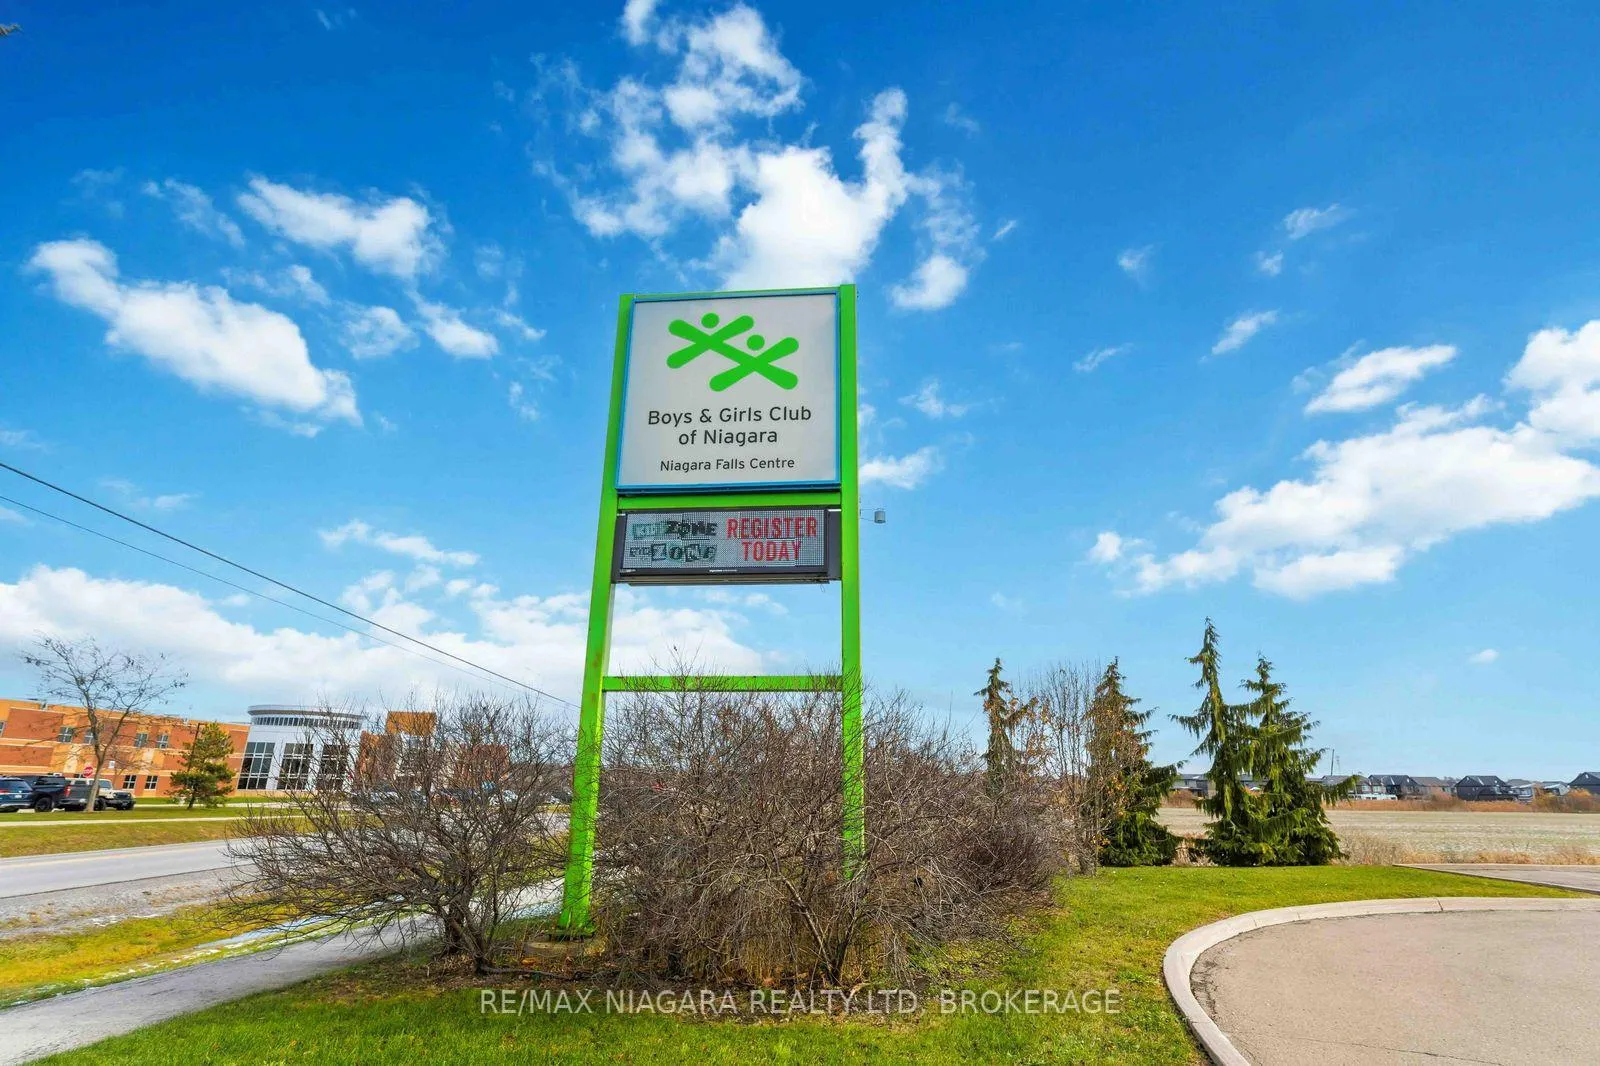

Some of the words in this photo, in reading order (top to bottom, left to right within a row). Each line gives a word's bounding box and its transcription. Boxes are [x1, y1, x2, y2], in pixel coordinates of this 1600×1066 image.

[648, 410, 693, 427] Boys
[699, 408, 712, 423] &
[719, 407, 762, 422] Girls
[769, 406, 812, 421] Club
[678, 429, 697, 445] of
[703, 429, 778, 446] Niagara
[660, 460, 711, 473] Niagara
[716, 458, 745, 470] Falls
[749, 457, 795, 470] Centre
[726, 516, 818, 539] REGISTER
[741, 540, 802, 561] TODAY
